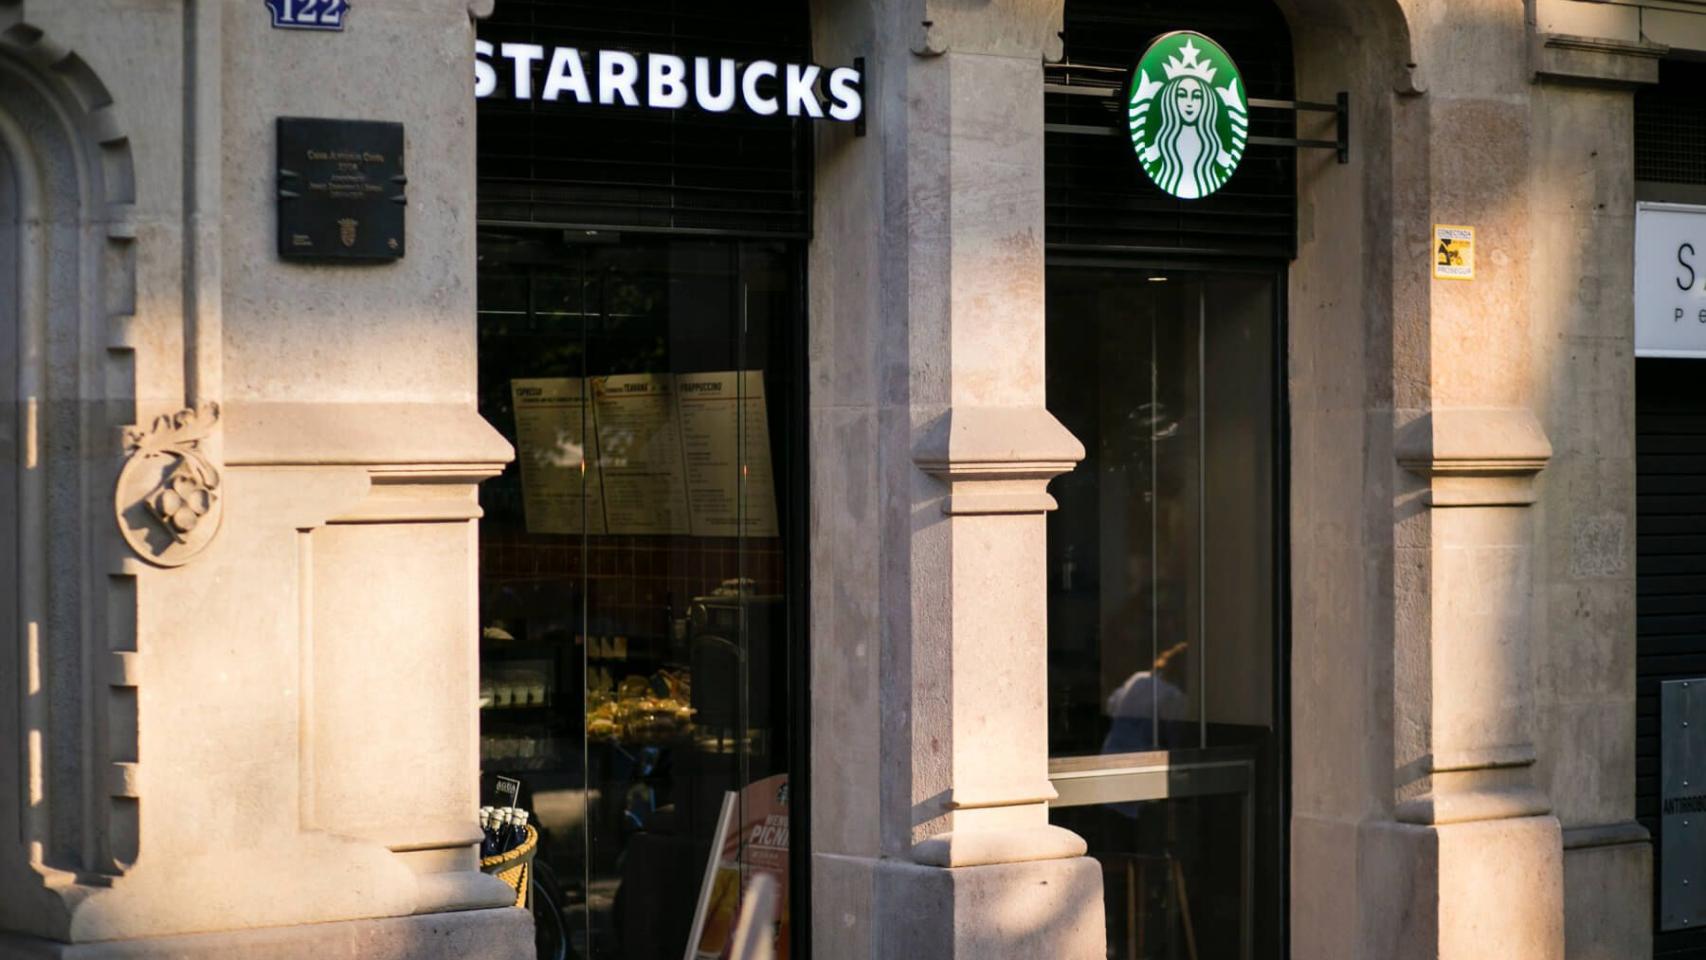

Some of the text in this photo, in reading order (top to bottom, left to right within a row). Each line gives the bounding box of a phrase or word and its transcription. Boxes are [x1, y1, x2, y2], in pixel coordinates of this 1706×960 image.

[280, 0, 340, 23] 122
[475, 39, 863, 121] STARBUCKS
[749, 824, 790, 848] PICNI
